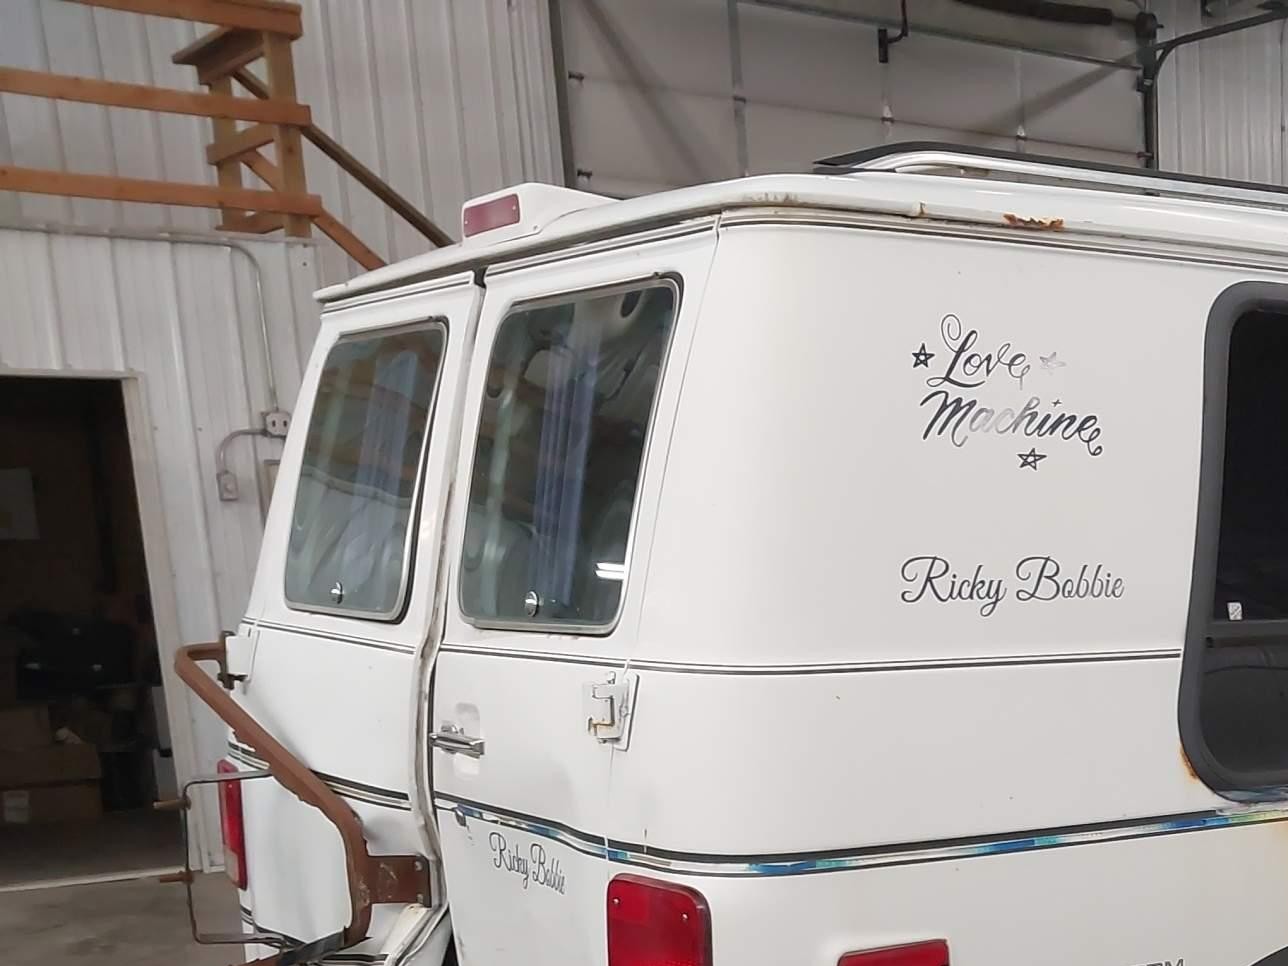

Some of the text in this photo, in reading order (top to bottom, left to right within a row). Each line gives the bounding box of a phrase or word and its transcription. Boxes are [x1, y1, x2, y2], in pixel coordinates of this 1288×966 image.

[926, 313, 1030, 391] Love
[919, 390, 1103, 457] Machine
[900, 555, 1125, 617] Ricky Bobbie
[488, 831, 565, 895] Ricky Bobbie
